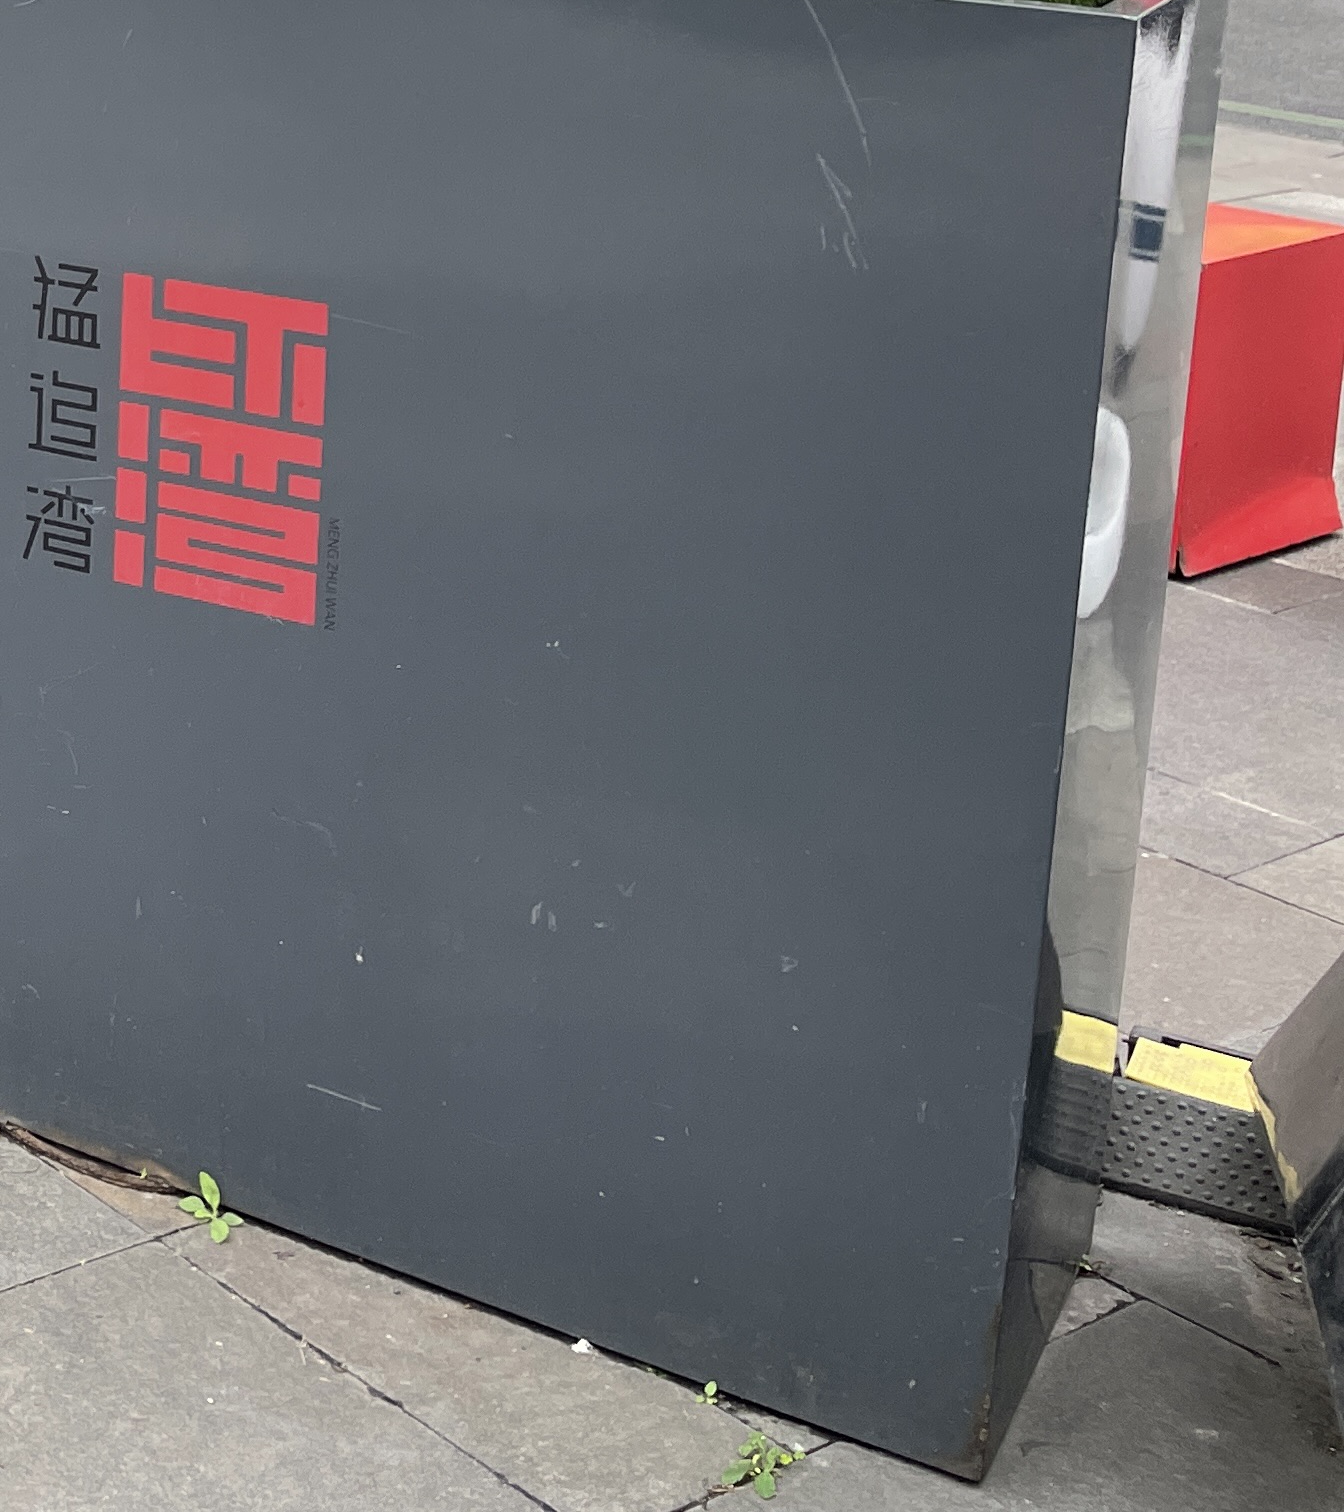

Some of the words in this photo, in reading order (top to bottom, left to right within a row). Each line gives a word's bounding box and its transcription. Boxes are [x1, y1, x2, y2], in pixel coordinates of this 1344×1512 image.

[22, 254, 101, 575] 猛追湾
[326, 516, 341, 560] MENG
[325, 561, 339, 594] ZHUI
[323, 596, 338, 632] WAN
